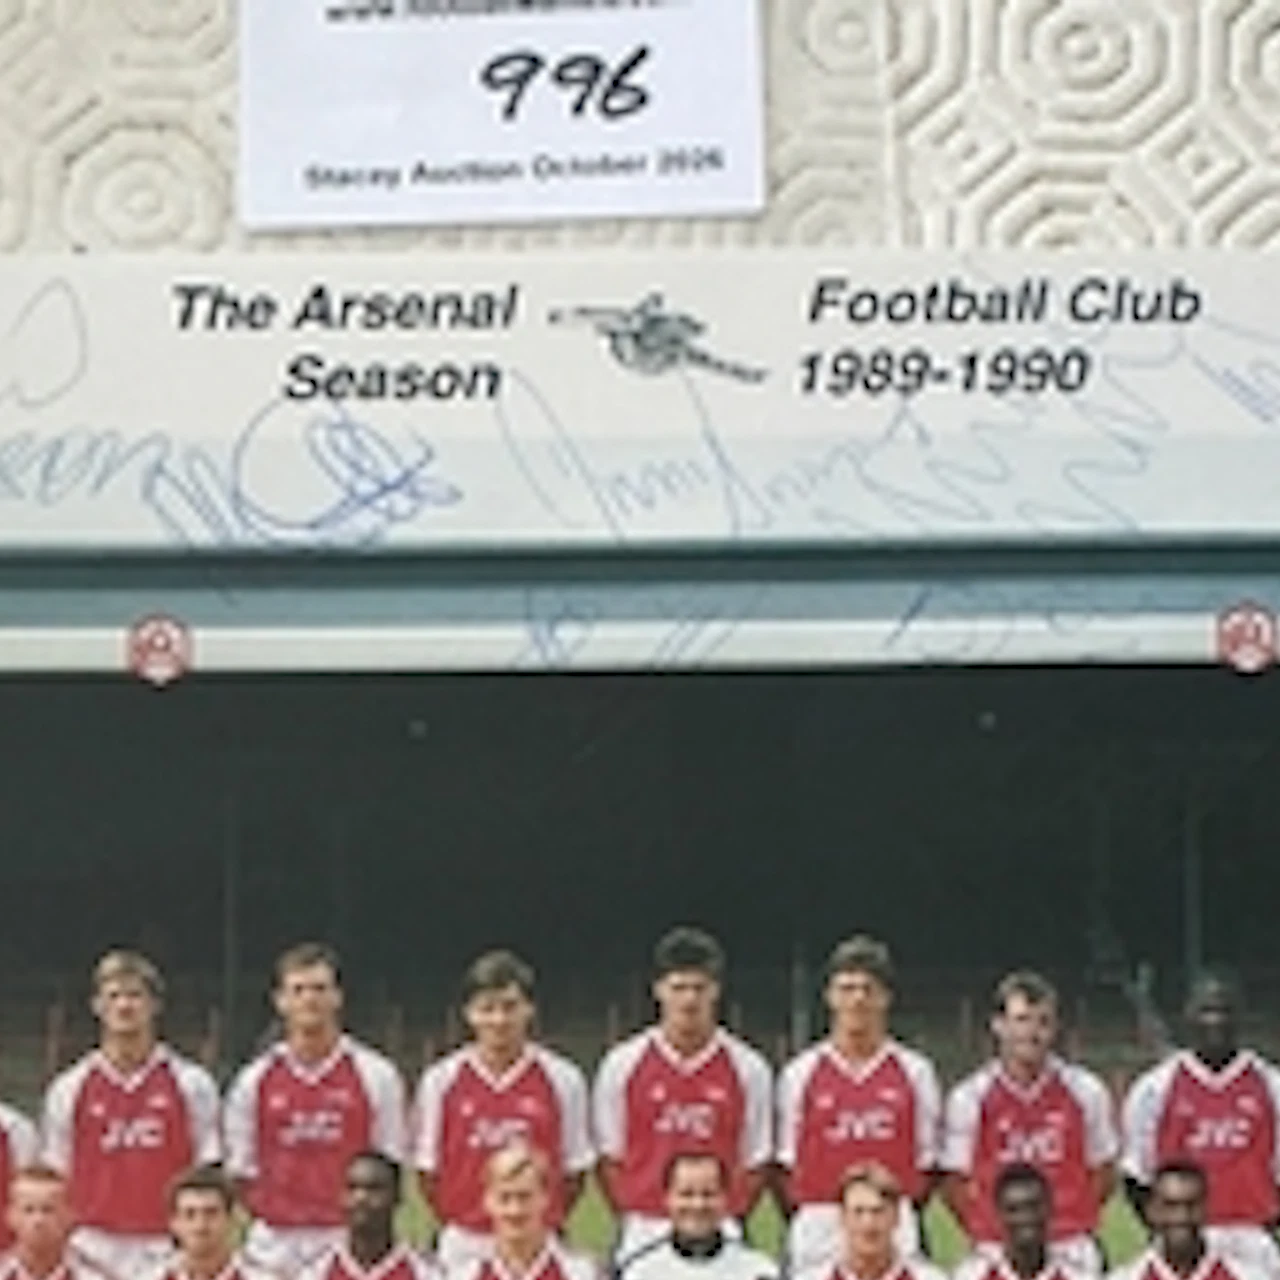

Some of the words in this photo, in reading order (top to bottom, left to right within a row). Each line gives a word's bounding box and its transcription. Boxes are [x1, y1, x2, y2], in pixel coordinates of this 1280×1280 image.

[480, 43, 651, 121] 996
[411, 158, 521, 186] Auction
[531, 152, 647, 181] October
[173, 284, 278, 330] The
[291, 284, 518, 331] Arsenal
[808, 277, 1049, 324] Football
[1069, 277, 1202, 325] Club
[283, 353, 502, 400] Season
[801, 350, 1091, 395] 1989-1990
[100, 1117, 165, 1153] JVC
[654, 1103, 715, 1139] JVC
[824, 1108, 898, 1145] JVC
[1185, 1118, 1254, 1150] JVC
[995, 1127, 1065, 1165] JVC
